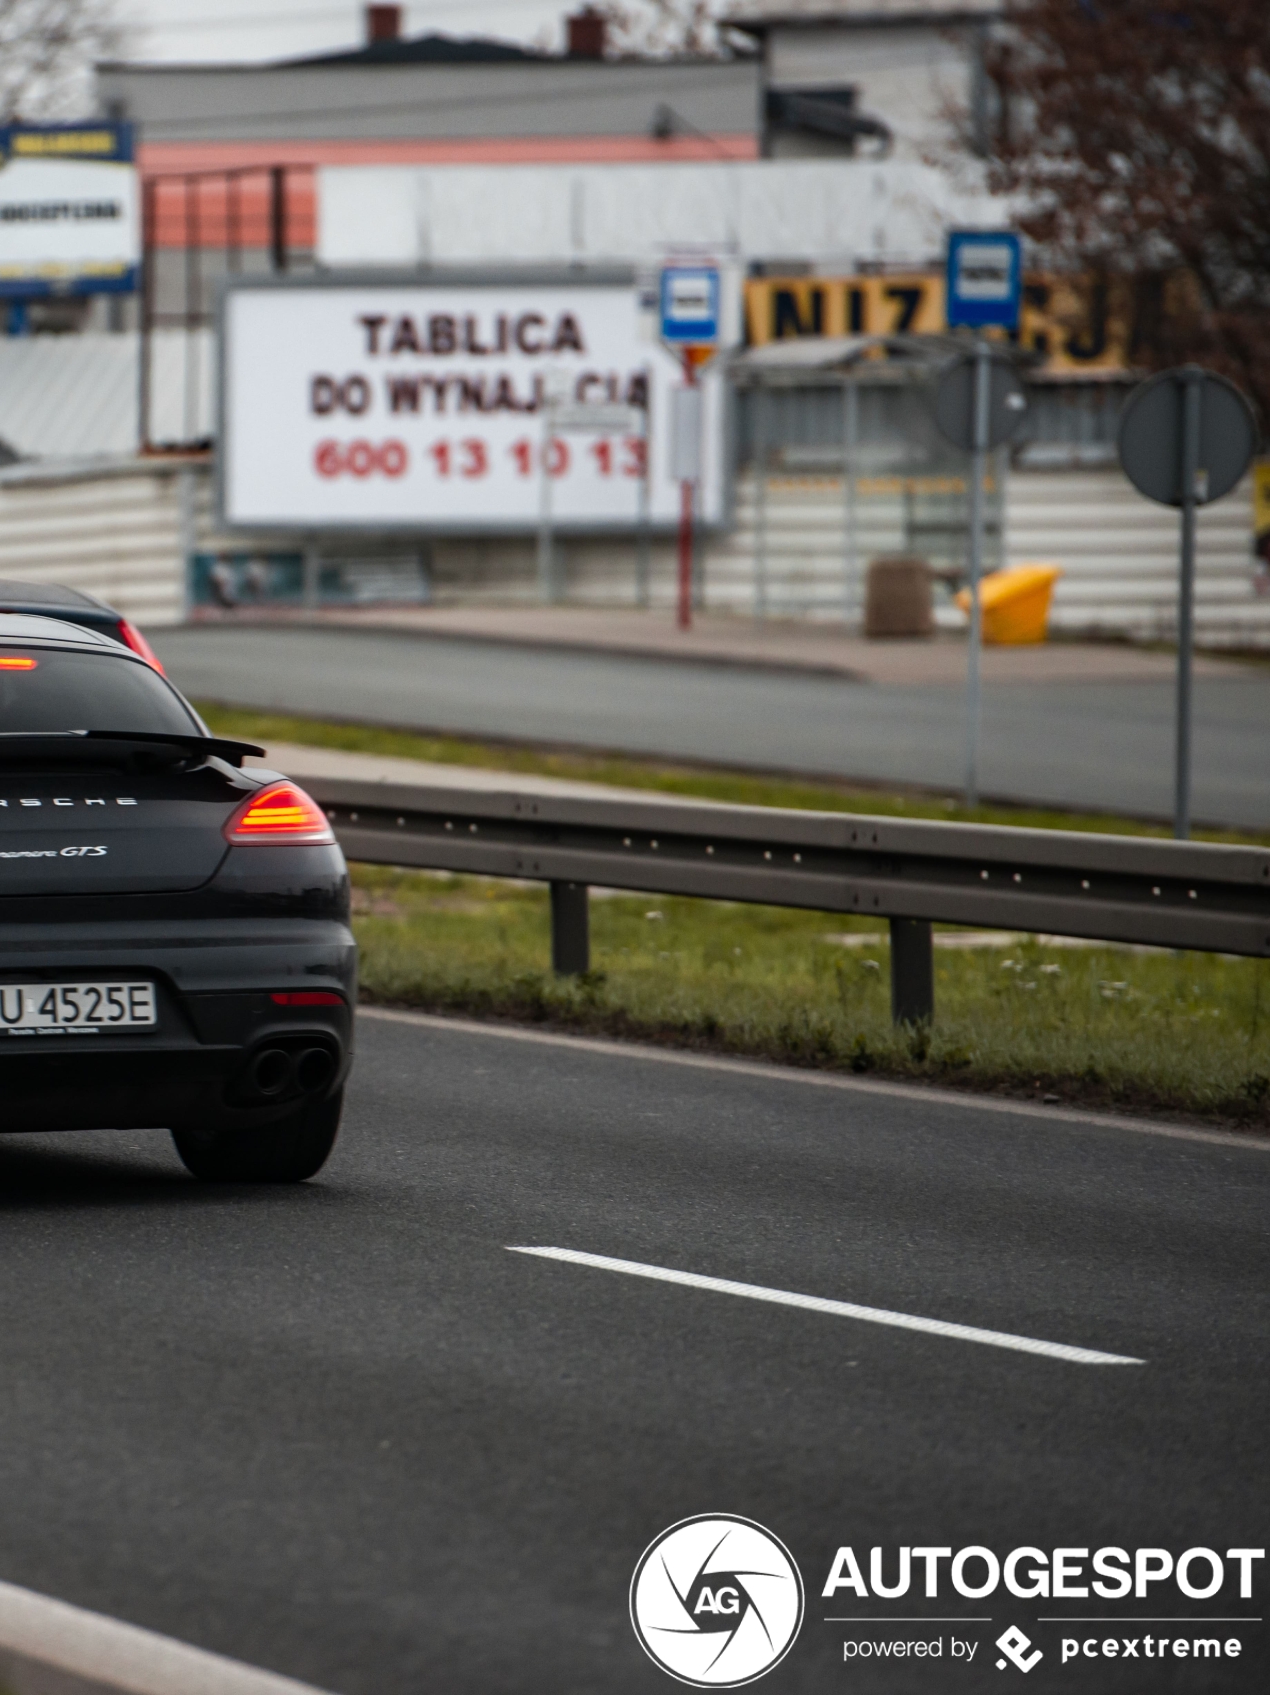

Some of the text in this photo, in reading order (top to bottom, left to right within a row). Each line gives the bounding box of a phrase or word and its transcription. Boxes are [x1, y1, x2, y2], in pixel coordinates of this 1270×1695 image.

[357, 312, 586, 356] TABLICA
[310, 373, 649, 416] DO WYNAJCIA
[312, 438, 649, 480] 600 13 10 13
[59, 846, 108, 857] GTS
[38, 985, 150, 1023] 4525E
